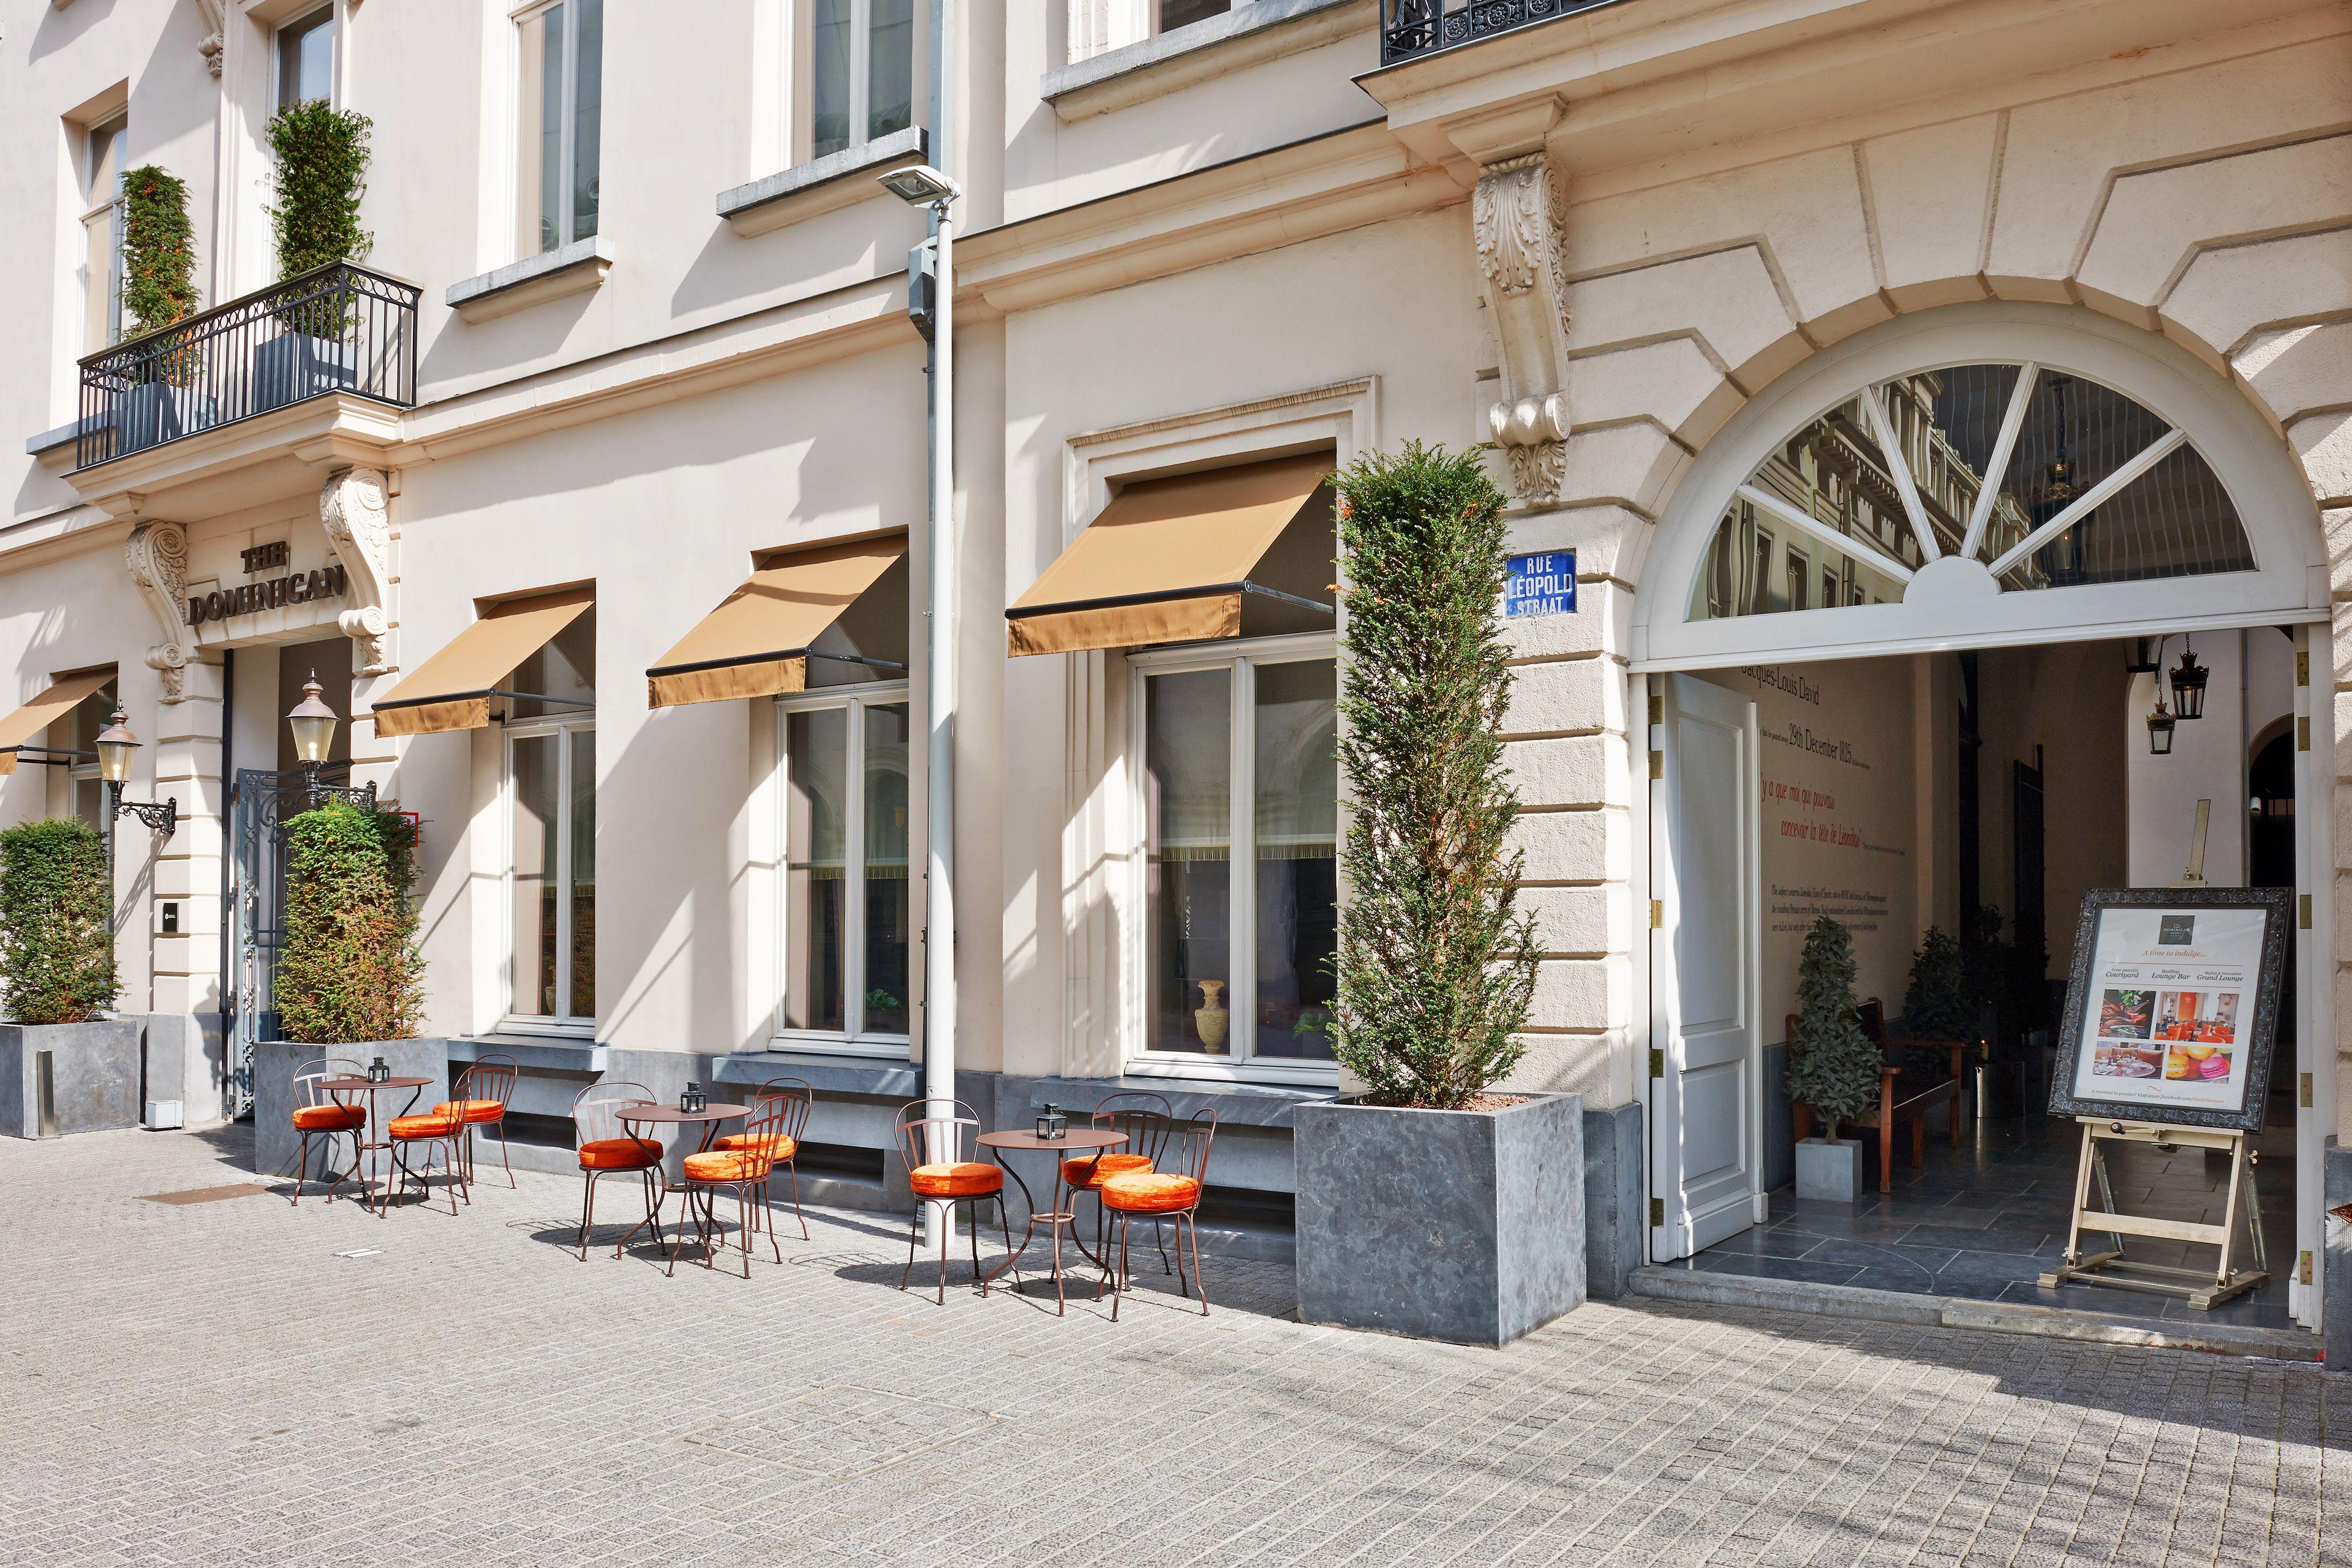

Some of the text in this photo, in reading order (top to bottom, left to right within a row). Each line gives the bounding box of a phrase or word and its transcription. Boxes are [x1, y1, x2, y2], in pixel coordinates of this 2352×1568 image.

[240, 540, 287, 574] THE
[1527, 555, 1553, 575] RUE
[187, 564, 344, 626] DOMINICAN
[1508, 573, 1573, 600] LÉOPOLD
[1516, 597, 1563, 617] STRAAT
[1799, 676, 1819, 705] David
[1789, 723, 1803, 749] 29th
[1806, 729, 1838, 760] December
[1839, 741, 1852, 764] 1825
[1769, 781, 1773, 797] a
[1776, 782, 1787, 805] que
[1789, 782, 1800, 804] moi
[1801, 785, 1811, 810] qui
[1813, 790, 1835, 812] pouvais
[1781, 818, 1809, 839] concevoir
[1811, 820, 1816, 840] la
[1819, 824, 1828, 843] tête
[1830, 823, 1837, 843] de
